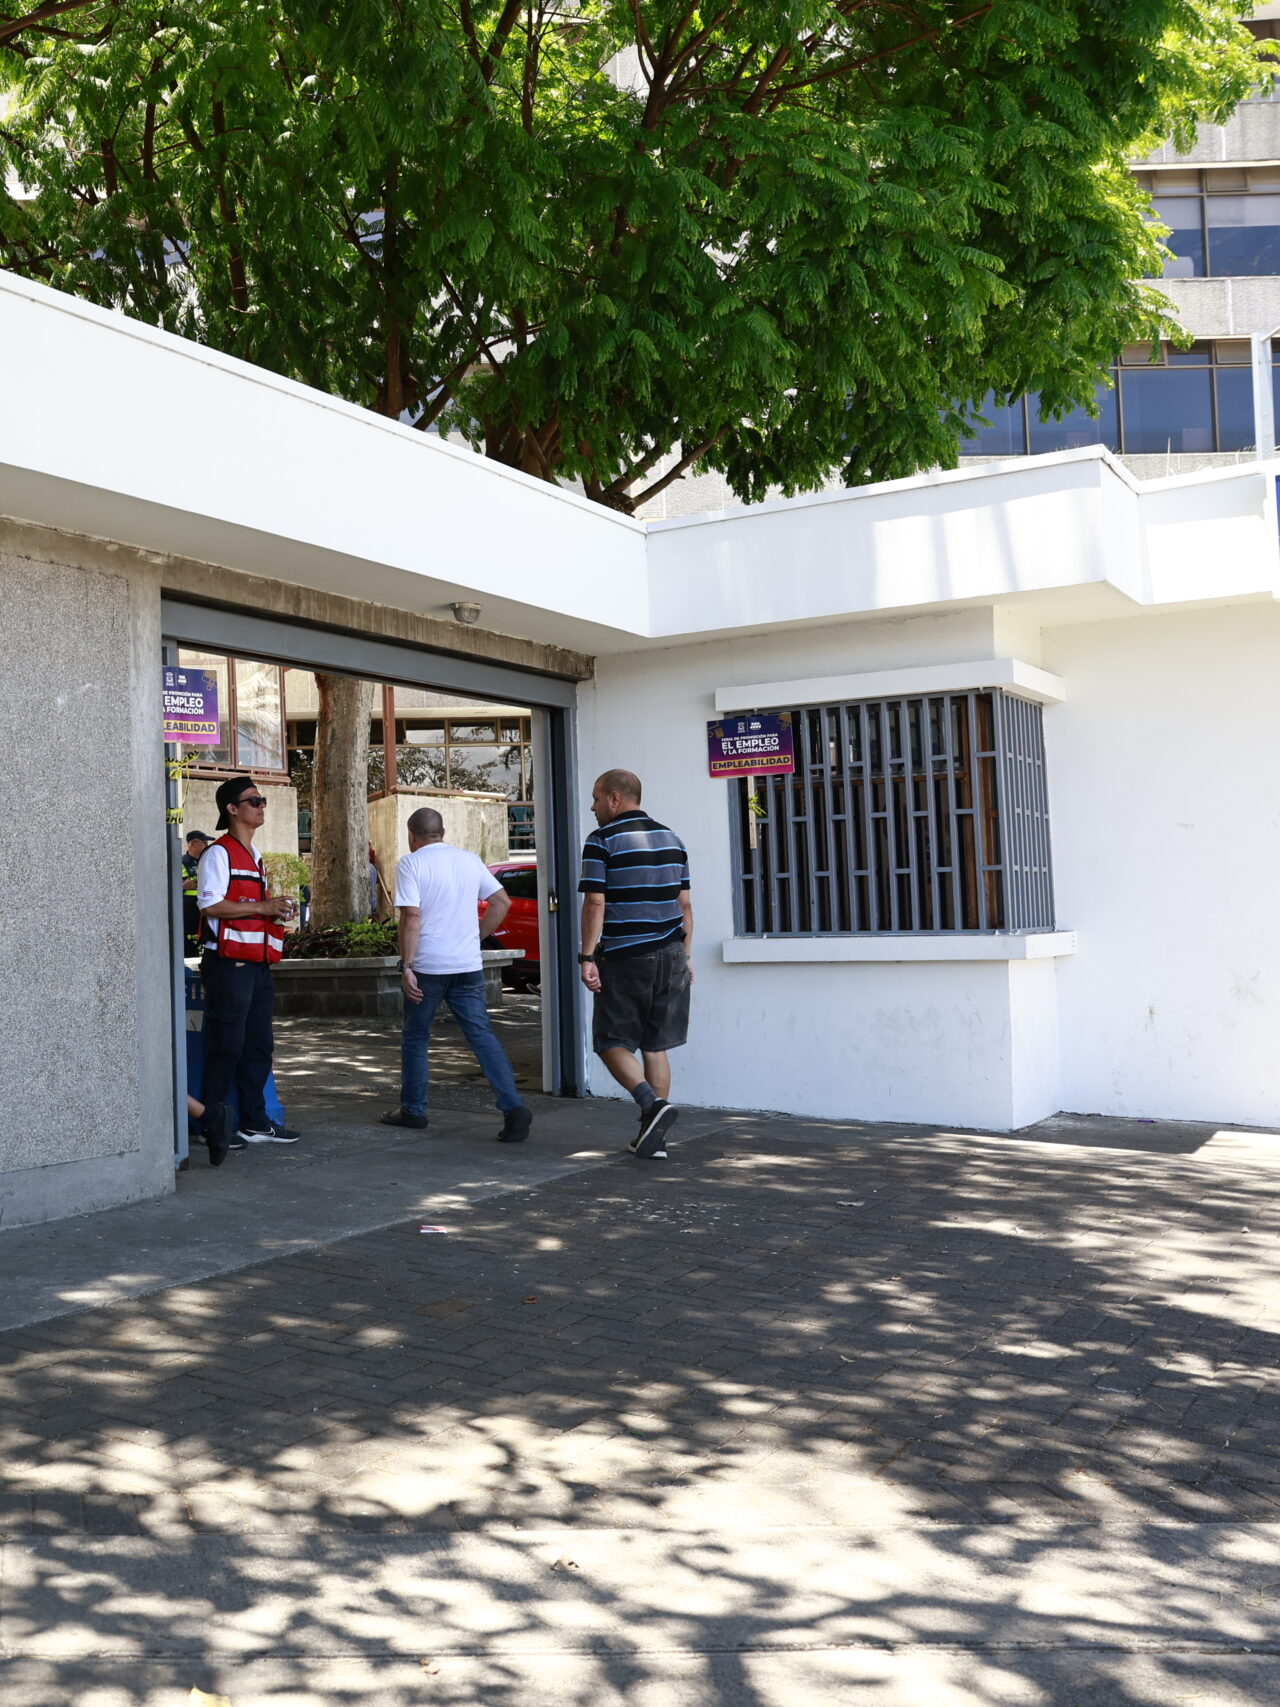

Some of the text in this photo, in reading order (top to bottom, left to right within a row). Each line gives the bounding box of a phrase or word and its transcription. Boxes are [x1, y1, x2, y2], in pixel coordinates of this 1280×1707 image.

[164, 695, 204, 708] EMPLEO
[166, 706, 204, 715] FORMACIÓN
[721, 737, 779, 750] EL EMPLEO
[738, 745, 780, 754] FORMACIÓN
[712, 756, 790, 770] EMPLEABILIDAD
